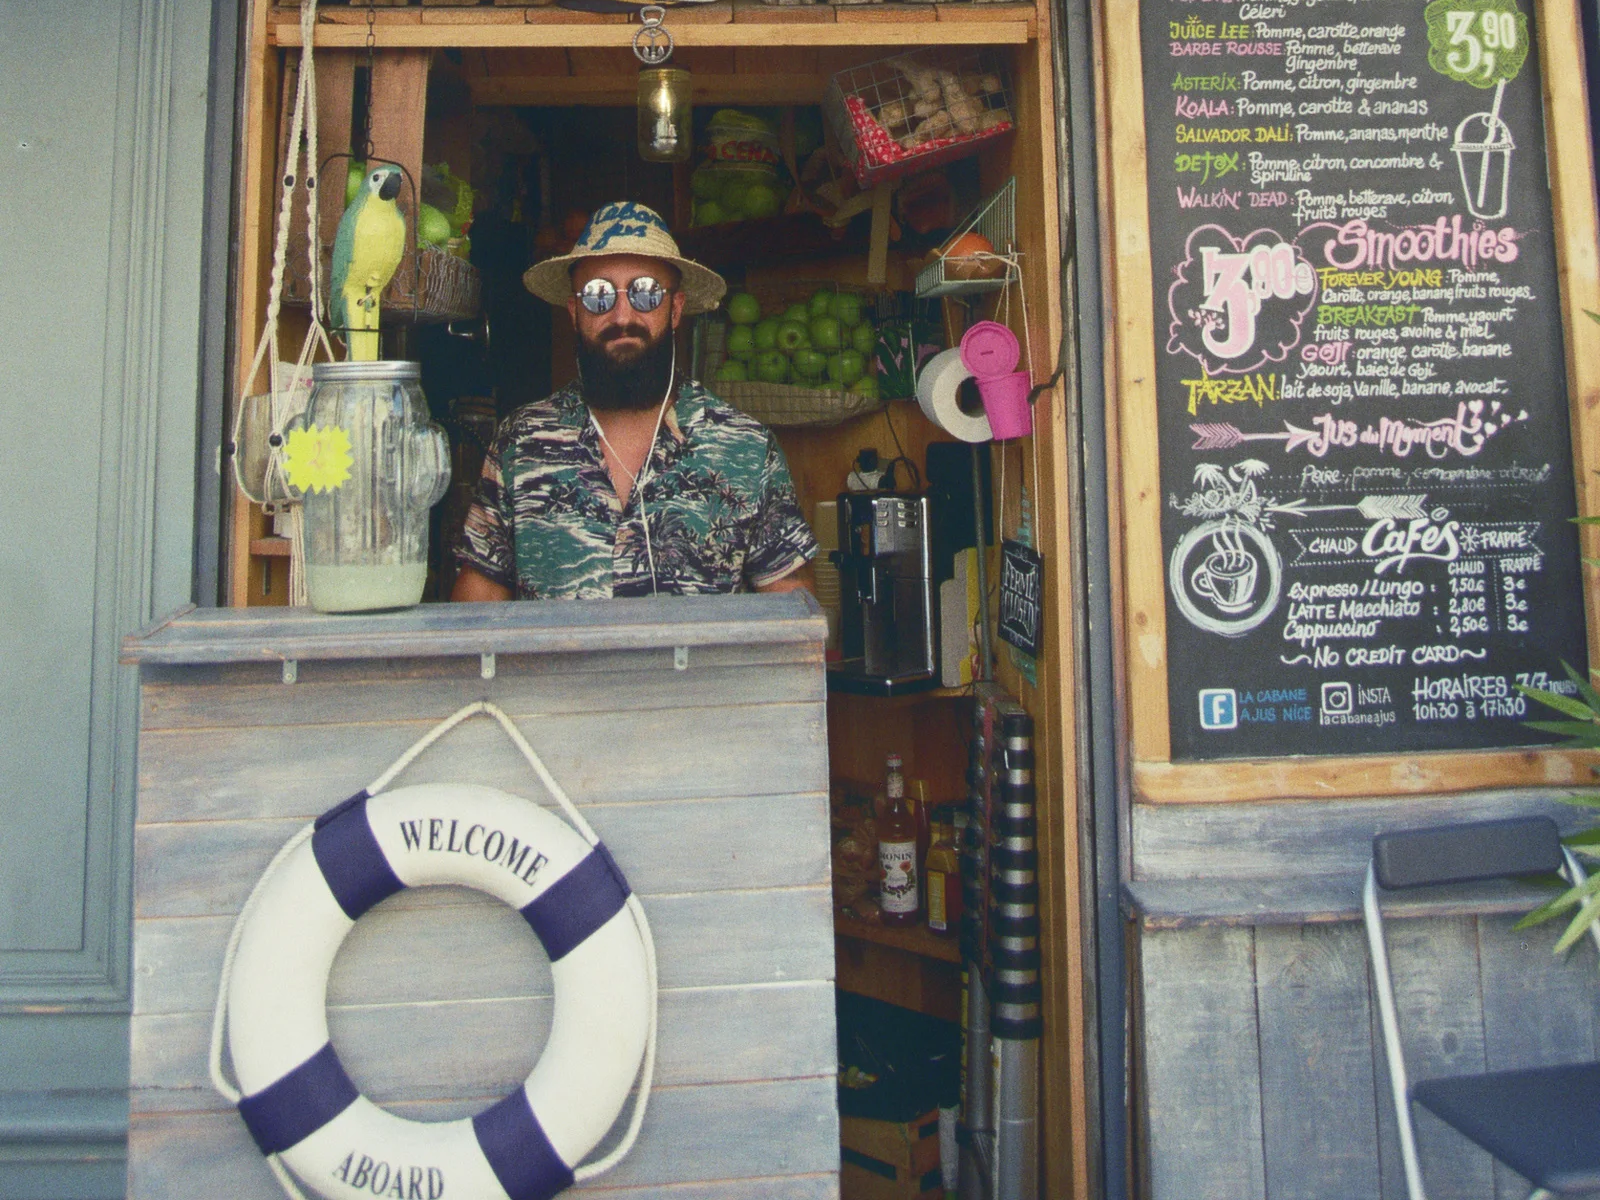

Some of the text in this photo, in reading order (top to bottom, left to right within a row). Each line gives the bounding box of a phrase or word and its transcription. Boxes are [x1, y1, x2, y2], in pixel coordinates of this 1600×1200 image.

[1239, 4, 1286, 20] Céleri
[1361, 23, 1405, 42] orange
[1170, 42, 1221, 56] BARBE
[1286, 55, 1358, 74] gingembre
[1347, 74, 1418, 94] gingembre
[1299, 98, 1352, 115] carotte
[1357, 98, 1371, 115] &
[1372, 100, 1428, 116] ananas
[1175, 124, 1252, 143] SALVADOR
[1398, 123, 1448, 144] menthe
[1429, 153, 1443, 170] &
[1412, 188, 1454, 205] citron
[1292, 205, 1387, 226] fruits rouges
[1324, 215, 1519, 272] Smoothies
[1316, 267, 1385, 290] FOREVER
[1454, 284, 1487, 300] fruits
[1317, 304, 1420, 326] BREAKFAST
[1469, 308, 1516, 327] yaourt
[1313, 324, 1350, 342] fruits
[1401, 325, 1442, 339] avoine
[1444, 325, 1457, 340] &
[1462, 339, 1512, 357] banane
[1356, 362, 1389, 377] baies
[1389, 361, 1405, 377] de
[1281, 374, 1305, 399] lait
[1306, 383, 1321, 398] de
[1308, 536, 1358, 554] CHAUD
[1479, 526, 1529, 550] FRAPPÉ
[1448, 554, 1542, 575] CHAUD FRAPPÉ
[1503, 576, 1526, 592] 3€
[1287, 601, 1336, 620] LATTE
[1338, 599, 1420, 619] Macchiato
[1505, 593, 1528, 611] 3€
[1283, 620, 1381, 648] Cappuccino
[1507, 614, 1529, 632] 3€
[1345, 645, 1406, 665] CREDIT
[1411, 645, 1460, 664] CARD
[1239, 688, 1308, 705] LA CABANE
[1358, 684, 1391, 705] INSTA
[1411, 673, 1508, 701] HORAIRES
[1283, 704, 1313, 722] NICE
[1319, 708, 1396, 727] lacabaneajus
[1412, 702, 1458, 721] 10h30
[1480, 697, 1526, 717] 17h30
[400, 818, 549, 887] WELCOME
[332, 1150, 445, 1200] ABOARD
